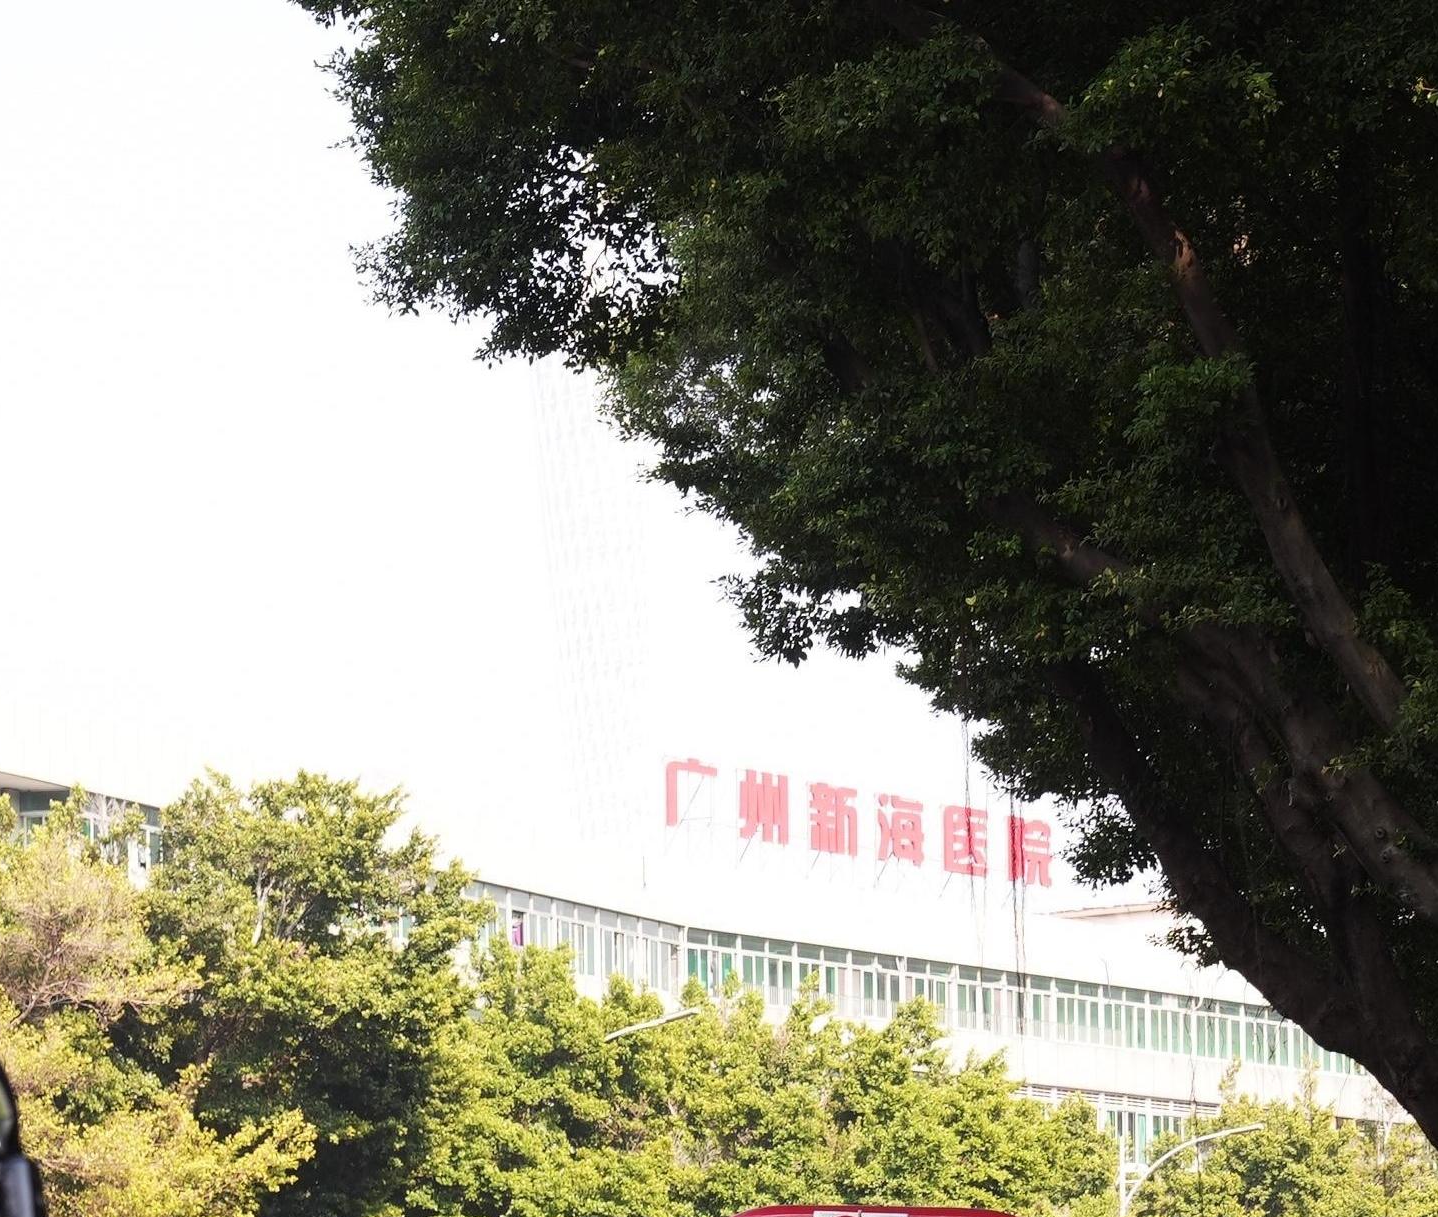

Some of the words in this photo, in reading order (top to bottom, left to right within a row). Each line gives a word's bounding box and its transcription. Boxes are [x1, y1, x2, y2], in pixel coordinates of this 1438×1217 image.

[666, 758, 1052, 888] 广州新海医院
